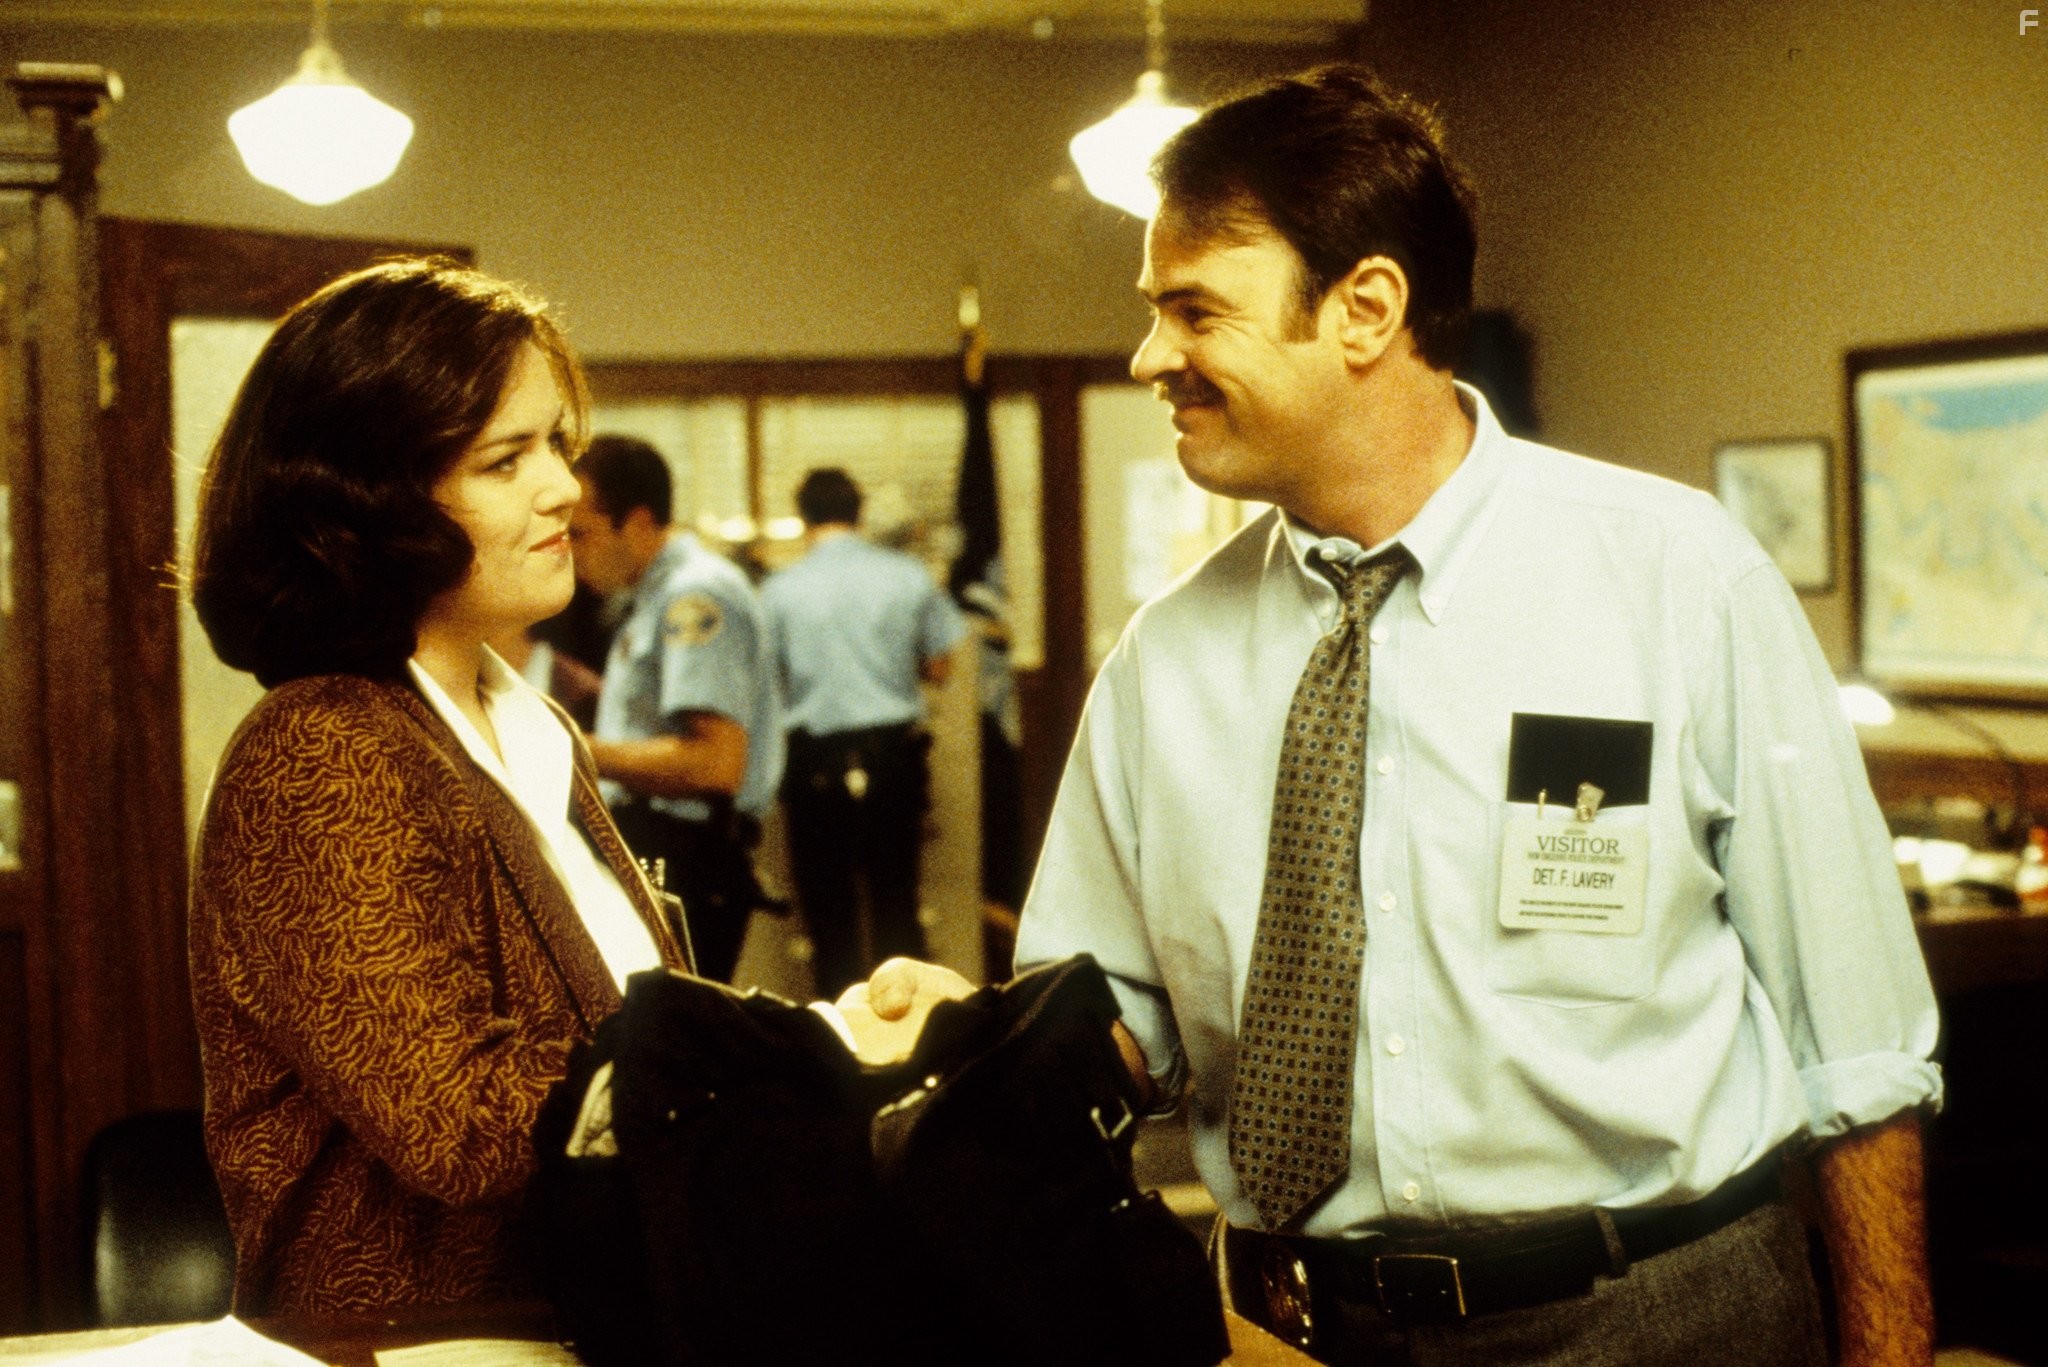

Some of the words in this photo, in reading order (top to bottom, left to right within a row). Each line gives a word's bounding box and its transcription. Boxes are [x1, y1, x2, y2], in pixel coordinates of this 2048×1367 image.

[1537, 836, 1619, 854] VISITOR
[1533, 868, 1557, 886] DET.
[1560, 870, 1570, 887] F.
[1573, 871, 1615, 889] LAVERY
